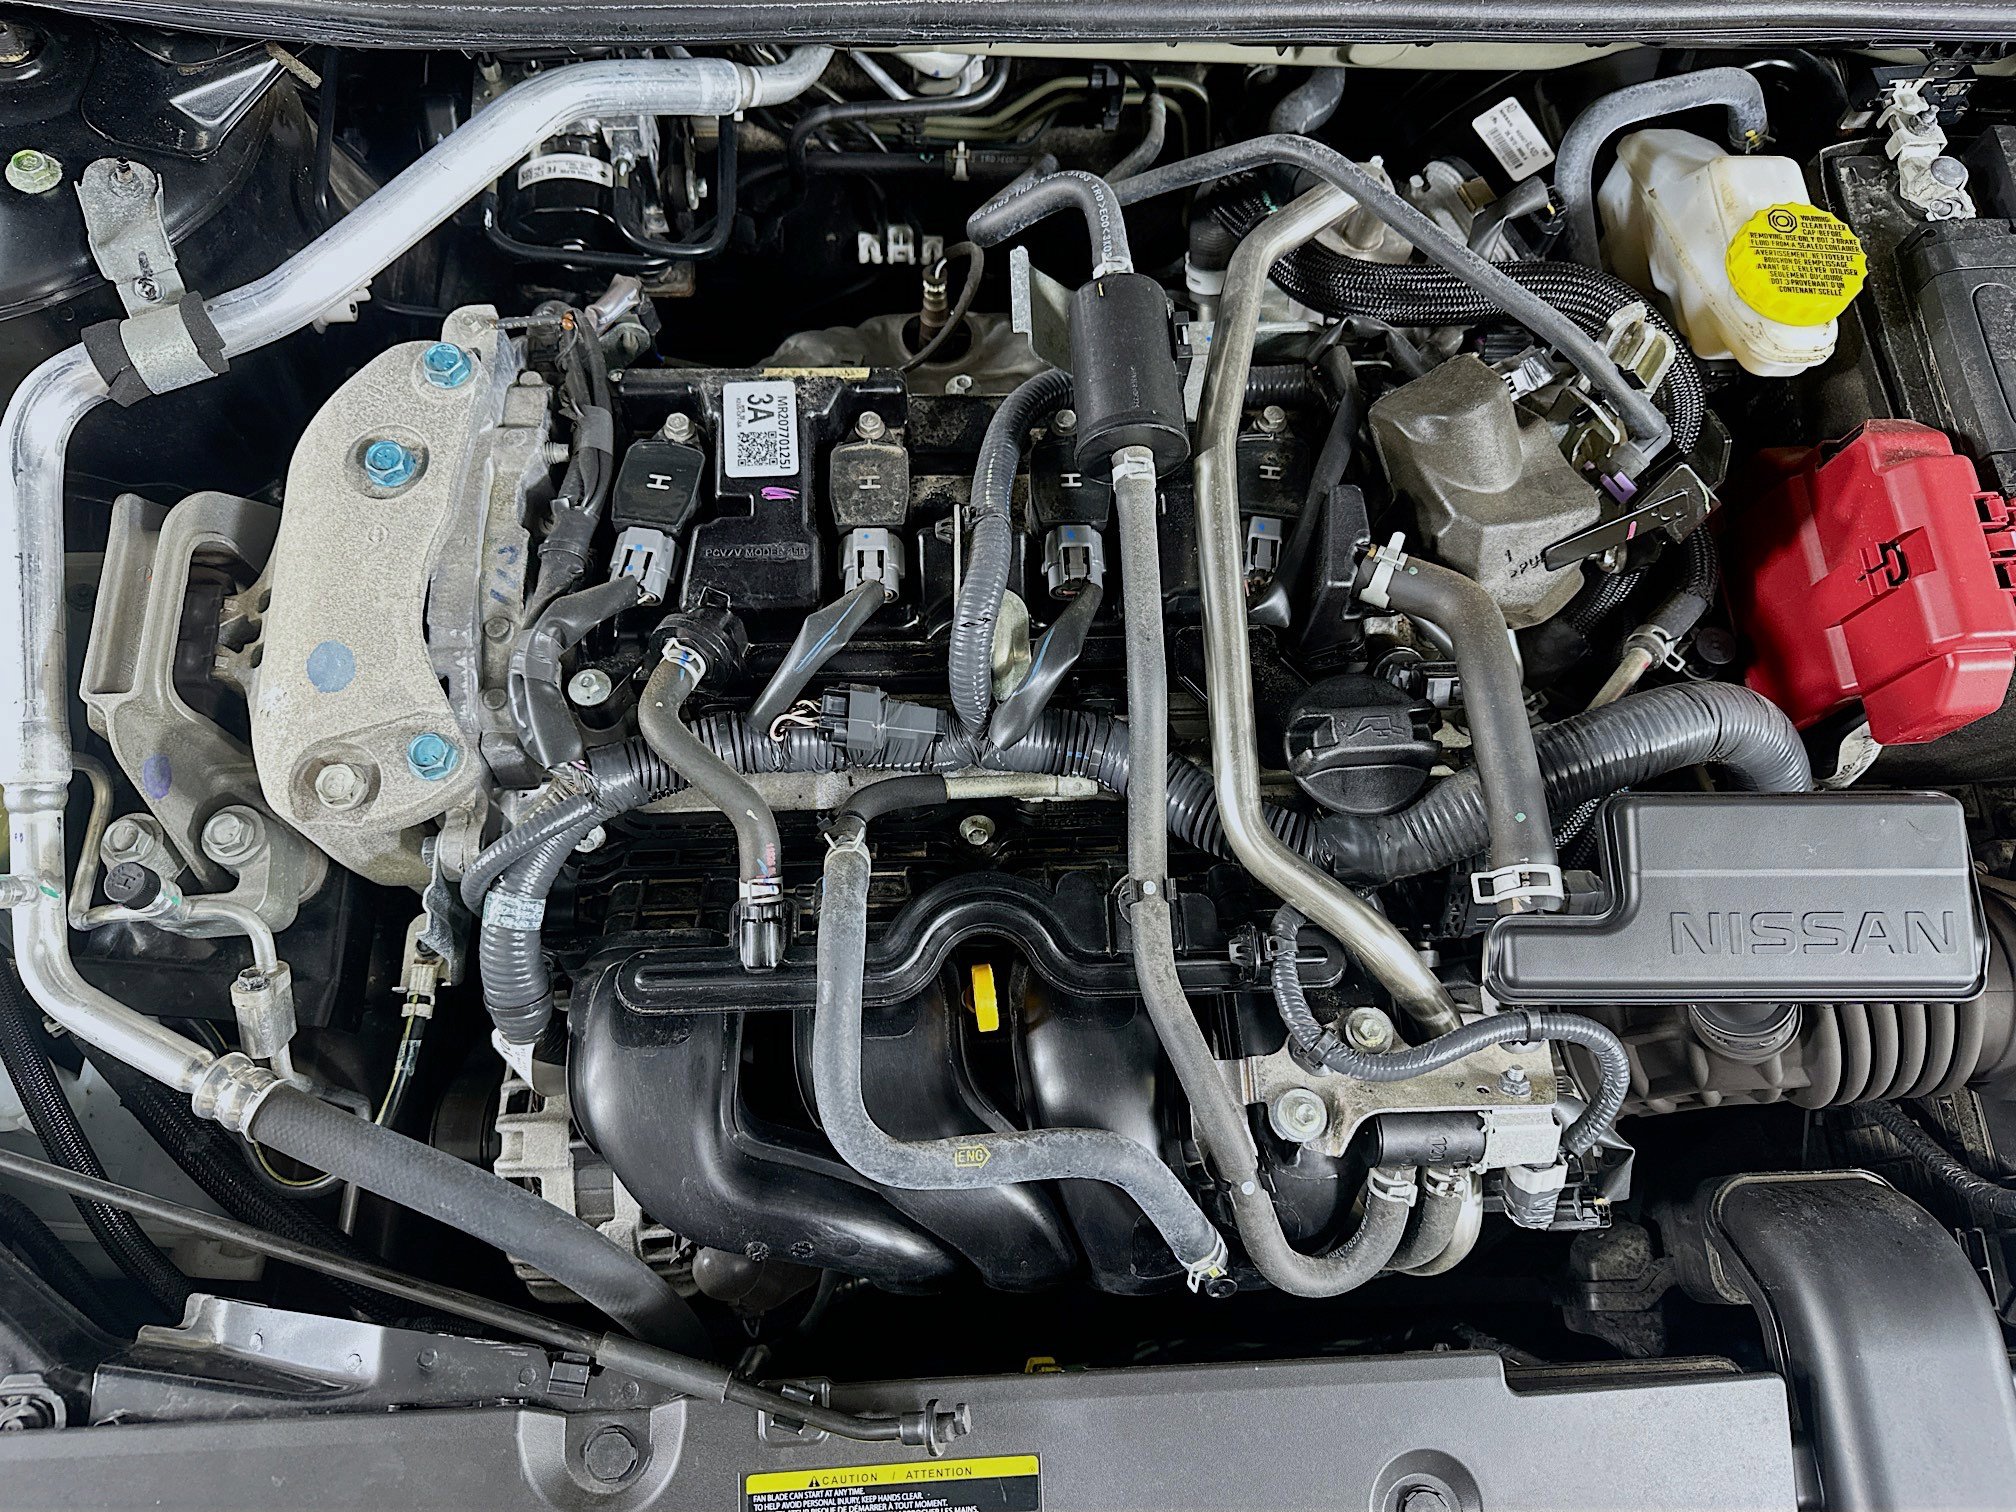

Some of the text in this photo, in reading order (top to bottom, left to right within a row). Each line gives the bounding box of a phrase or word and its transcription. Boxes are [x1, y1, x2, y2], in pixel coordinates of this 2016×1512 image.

[1824, 223, 1846, 231] FILLER
[1798, 242, 1823, 250] SEALED
[1763, 256, 1793, 264] BOUCHON
[1804, 259, 1847, 268] REMPLISSAGE
[1770, 270, 1808, 279] SEULEMENT
[1830, 268, 1858, 276] UTILISER
[1791, 279, 1829, 288] PROVENANT
[1779, 286, 1816, 294] CONTENANT
[747, 393, 774, 424] 3A
[778, 395, 791, 470] MR20770125J
[1670, 911, 1958, 955] NISSAN
[958, 1149, 984, 1163] ENG
[822, 1472, 878, 1486] CAUTION
[905, 1466, 973, 1480] ATTENTION
[753, 1494, 767, 1503] FAN
[768, 1492, 788, 1502] BLADE
[789, 1491, 804, 1500] CAN
[804, 1490, 824, 1499] START
[824, 1489, 833, 1497] AT
[753, 1504, 763, 1512] TO
[764, 1502, 781, 1511] HELP
[781, 1501, 803, 1510] AVOID
[803, 1499, 836, 1508] PERSONAL
[861, 1495, 877, 1504] KEEP
[877, 1493, 901, 1503] HANDS
[840, 1504, 848, 1512] DE
[848, 1501, 888, 1512] DÉMARRER
[894, 1500, 914, 1510] TOUT
